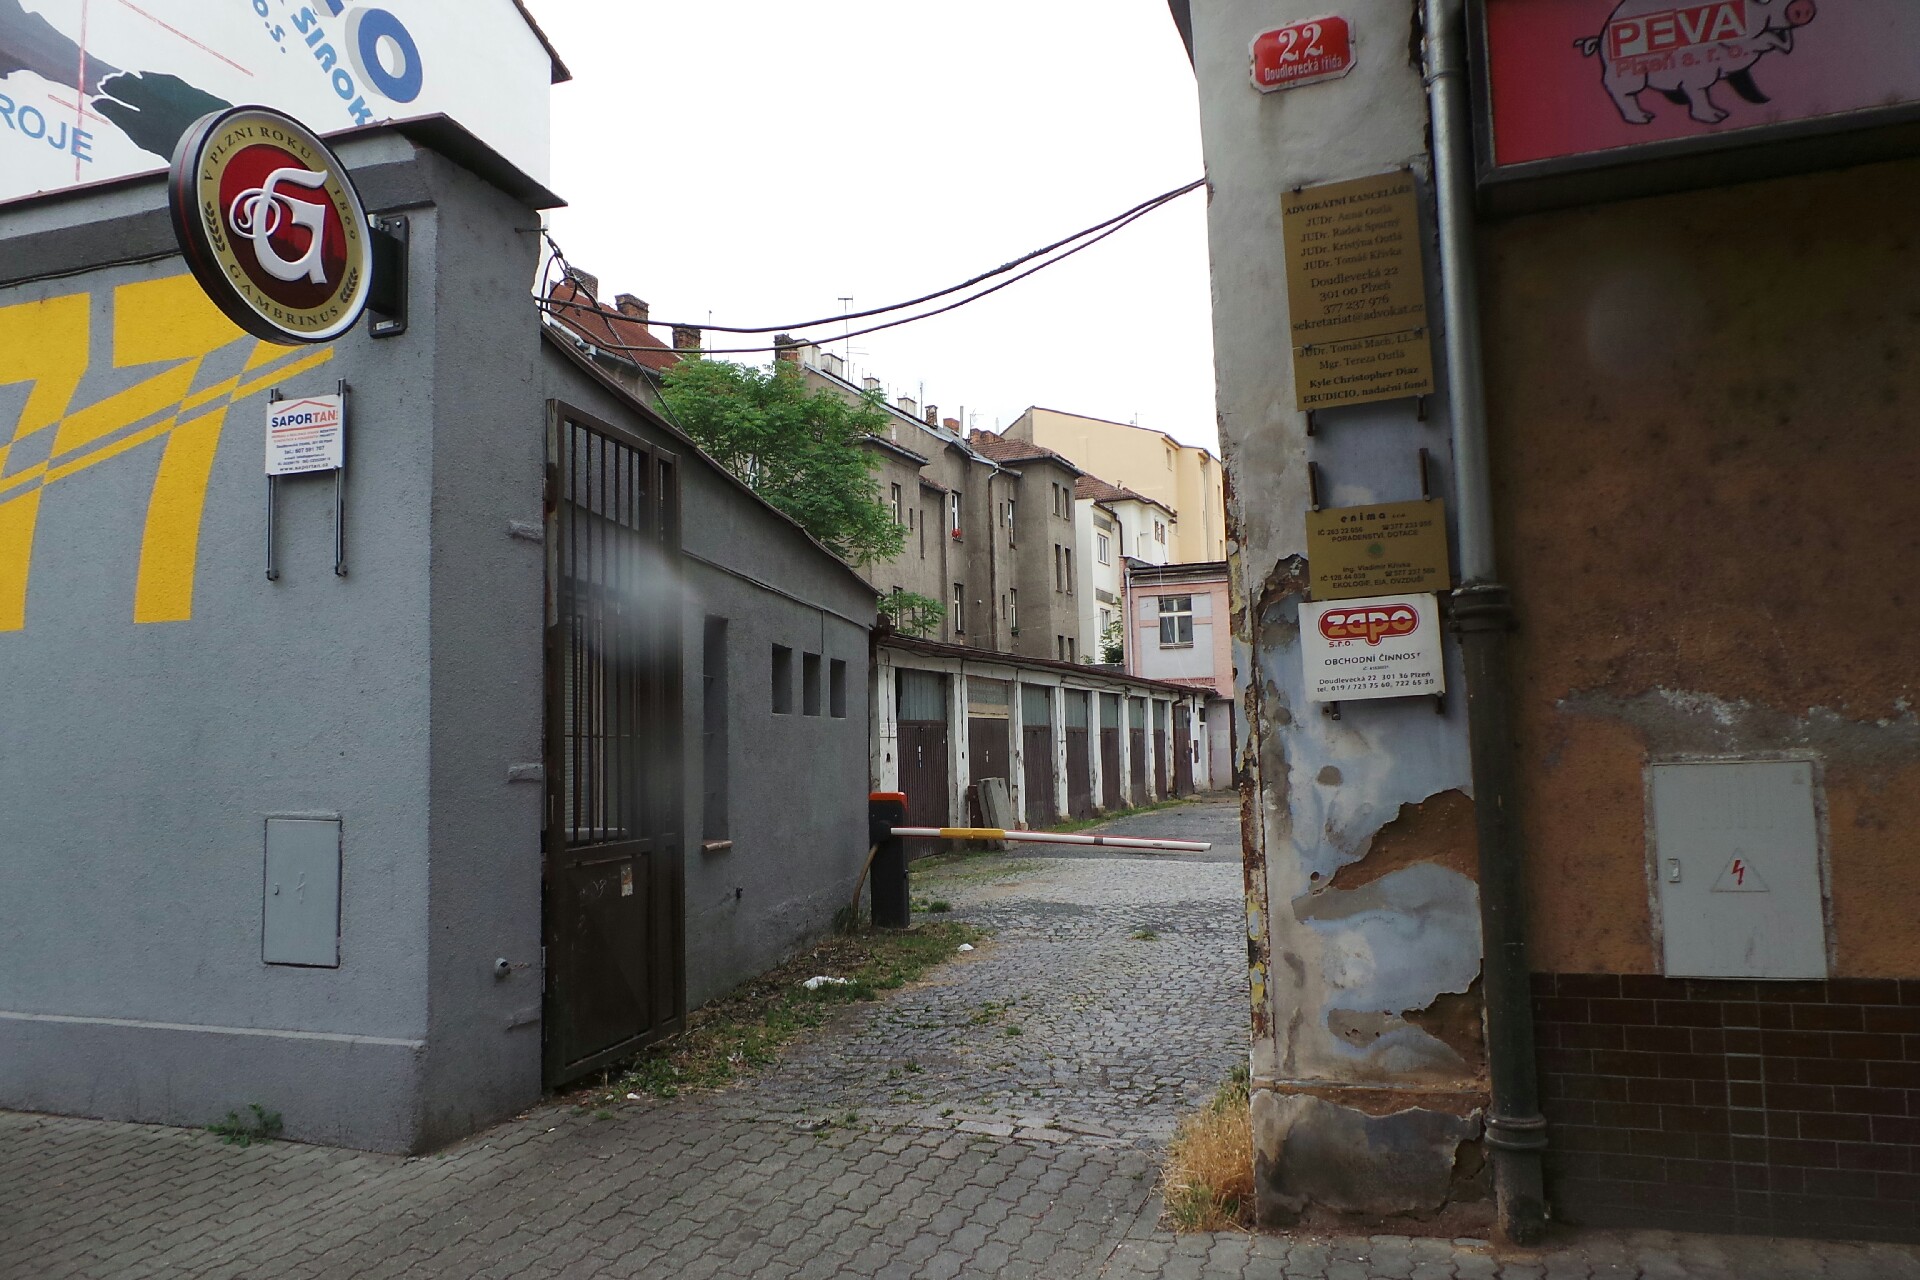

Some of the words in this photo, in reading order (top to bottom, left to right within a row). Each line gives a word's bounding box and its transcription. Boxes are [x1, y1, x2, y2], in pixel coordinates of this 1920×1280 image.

[1611, 3, 1747, 57] PEVA
[1278, 23, 1324, 64] 22
[290, 6, 377, 127] ŠIROK
[1264, 57, 1319, 81] Doudlevecká
[1320, 54, 1342, 71] třída
[1616, 50, 1676, 77] Plzeň
[1707, 47, 1721, 62] r.
[1727, 44, 1749, 58] o.
[204, 170, 214, 183] V
[210, 126, 254, 166] PLZNI
[259, 126, 312, 160] ROKU
[333, 188, 357, 241] 1869
[1305, 216, 1334, 228] JUDr.
[1301, 232, 1330, 243] JUDr.
[1332, 224, 1364, 238] Radek
[1301, 247, 1330, 257] JUDr.
[1332, 239, 1373, 252] Kristýna
[1303, 260, 1333, 271] JUDr.
[1334, 253, 1368, 266] Tomáš
[1311, 268, 1382, 289] Doudlevecká
[1384, 267, 1400, 277] 22
[229, 262, 340, 327] GAMBRINUS
[1319, 290, 1340, 302] 301
[1342, 287, 1358, 296] 00
[1361, 281, 1392, 295] Plzeň
[1323, 302, 1344, 316] 377
[1345, 299, 1367, 310] 237
[1368, 295, 1390, 308] 976
[1319, 359, 1342, 371] Mgr.
[1343, 354, 1376, 367] Tereza
[1309, 376, 1331, 389] Kyle
[1333, 369, 1394, 386] Christopher
[1403, 379, 1428, 391] fond
[271, 409, 336, 428] SAPORTAN
[1326, 609, 1413, 642] zapo
[1328, 639, 1354, 648] s.r.o.
[1324, 653, 1376, 666] OBCHODNÍ
[1319, 675, 1366, 686] Doudlevecká
[1367, 673, 1378, 682] 22
[1381, 673, 1396, 681] 301
[1330, 683, 1346, 692] 019
[1353, 682, 1367, 690] 723
[1369, 681, 1379, 689] 75
[1395, 679, 1410, 688] 722
[1412, 679, 1423, 687] 65
[1424, 678, 1435, 686] 30
